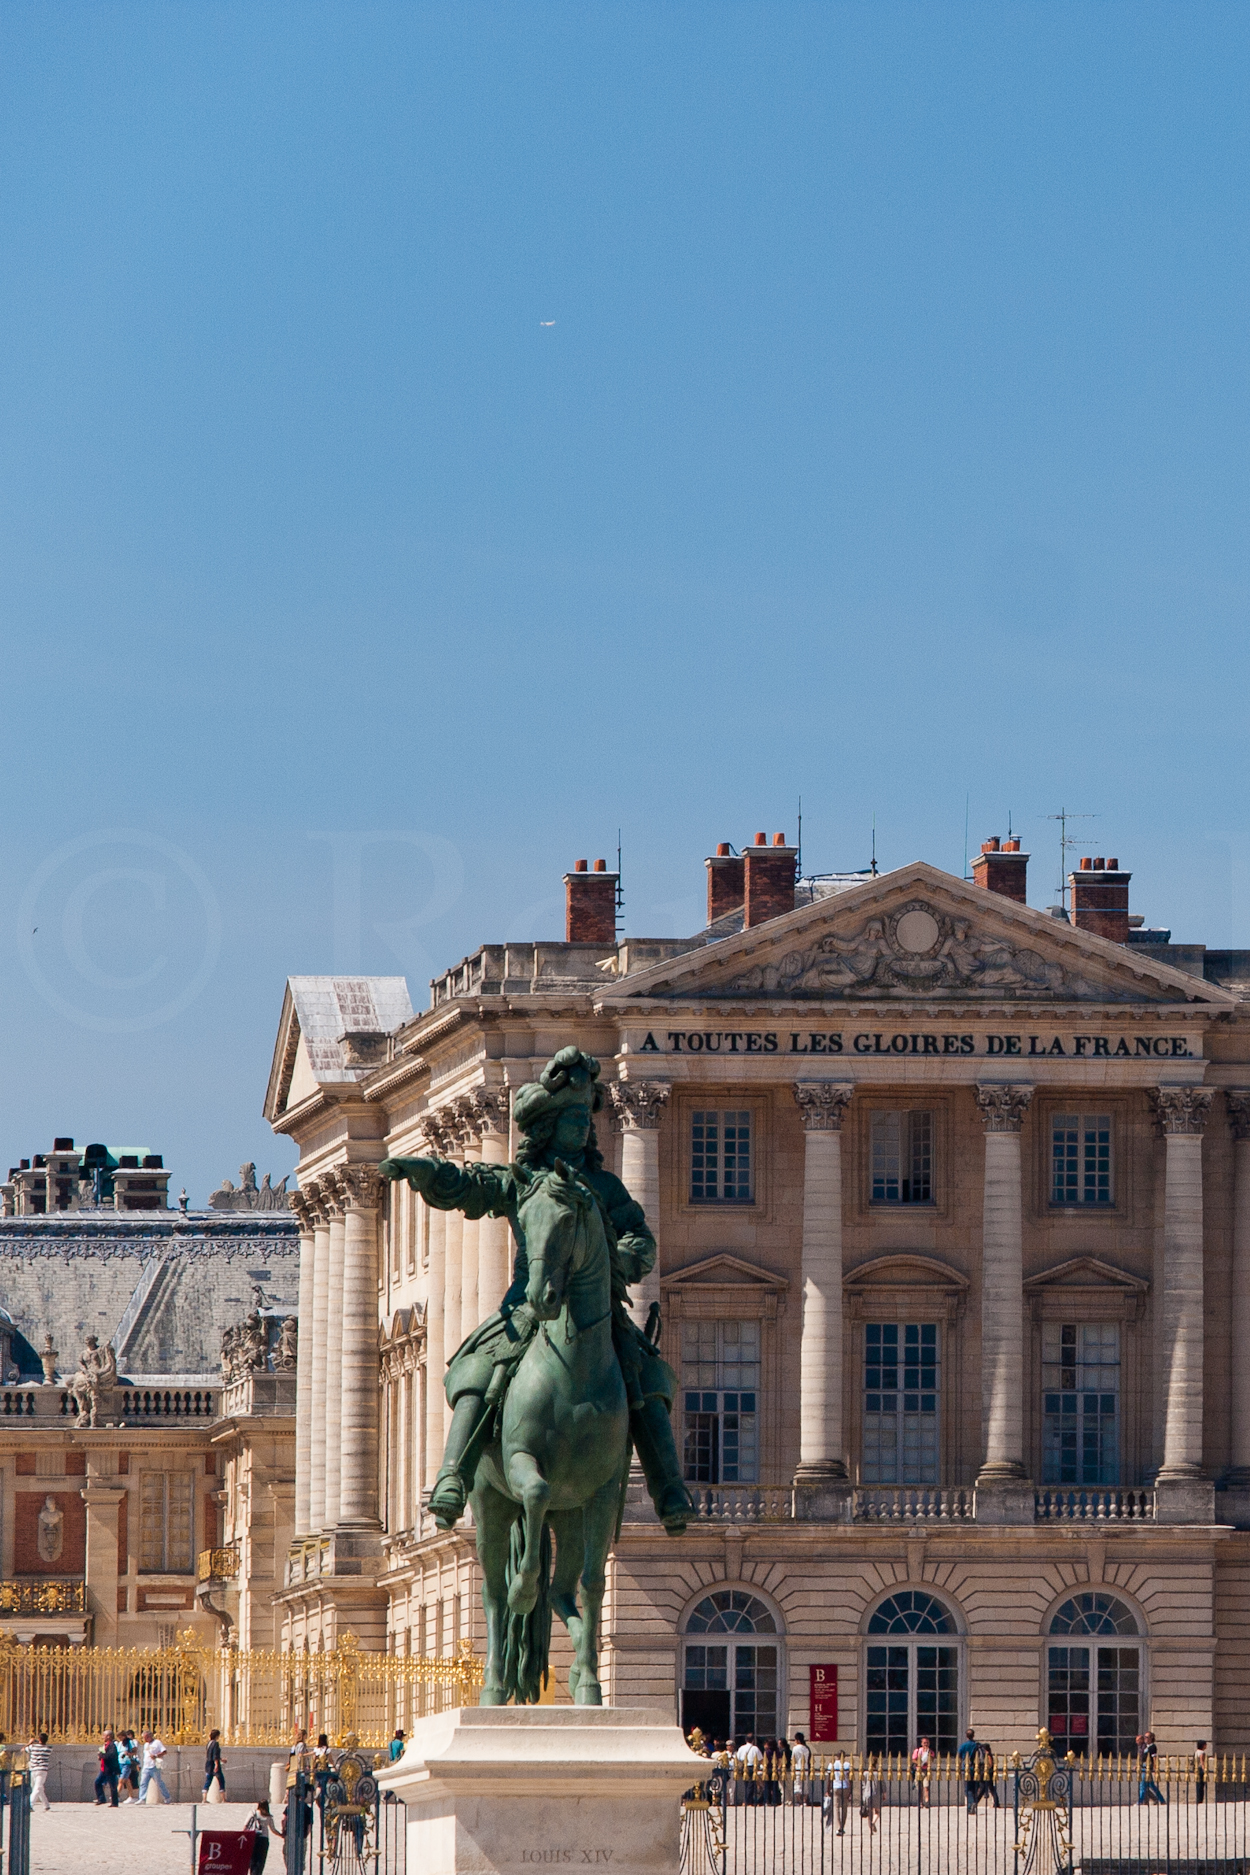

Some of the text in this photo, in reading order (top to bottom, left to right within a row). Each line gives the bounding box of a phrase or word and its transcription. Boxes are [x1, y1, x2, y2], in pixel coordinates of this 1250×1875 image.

[640, 1032, 1194, 1057] A TOUTES LES GLOIRES DE LA FRANCE.
[816, 1669, 825, 1682] B
[815, 1704, 822, 1712] H
[208, 1842, 221, 1860] B
[520, 1849, 614, 1863] LOUIS XIV
